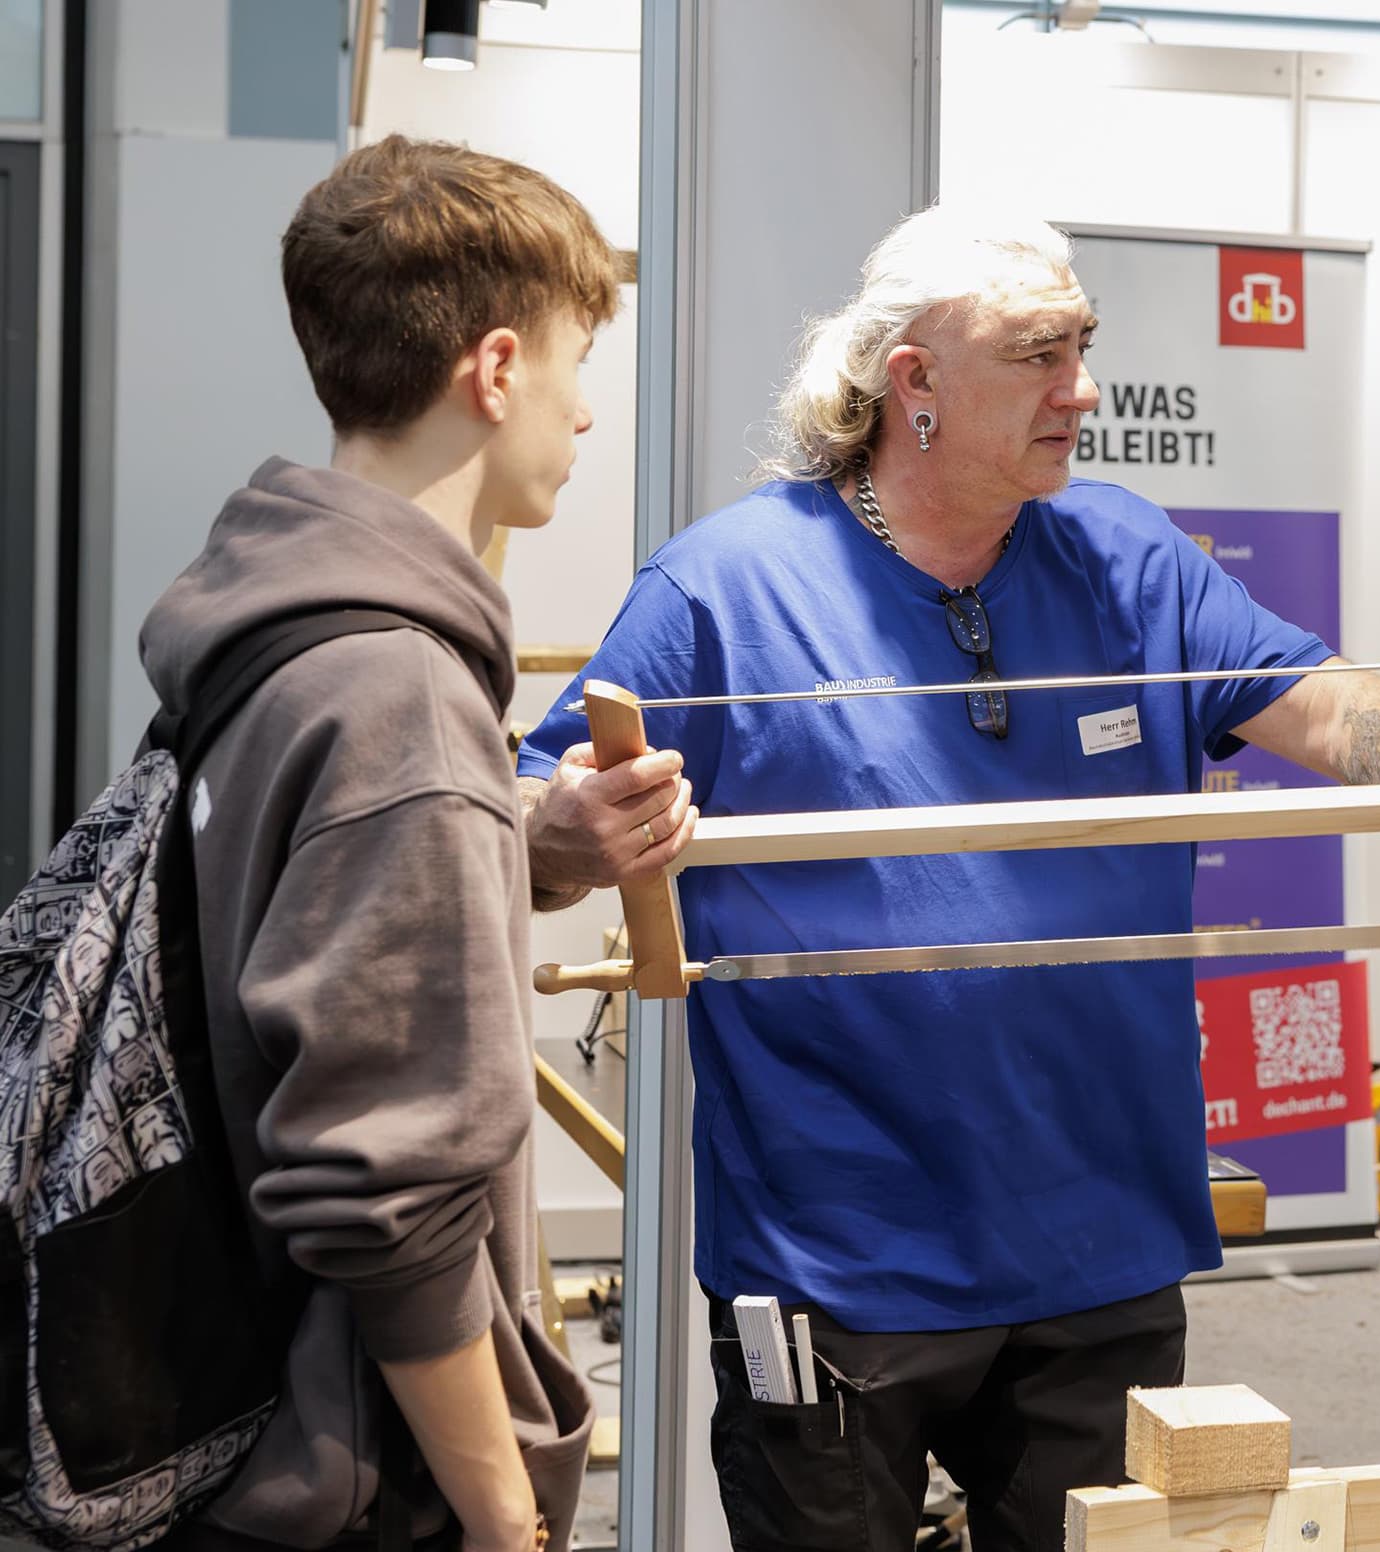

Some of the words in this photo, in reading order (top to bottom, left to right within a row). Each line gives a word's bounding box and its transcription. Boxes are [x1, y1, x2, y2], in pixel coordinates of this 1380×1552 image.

[1112, 384, 1196, 420] WAS
[1077, 428, 1215, 466] BLEIBT!
[1100, 722, 1120, 733] Herr
[1262, 1091, 1347, 1119] dechant.de
